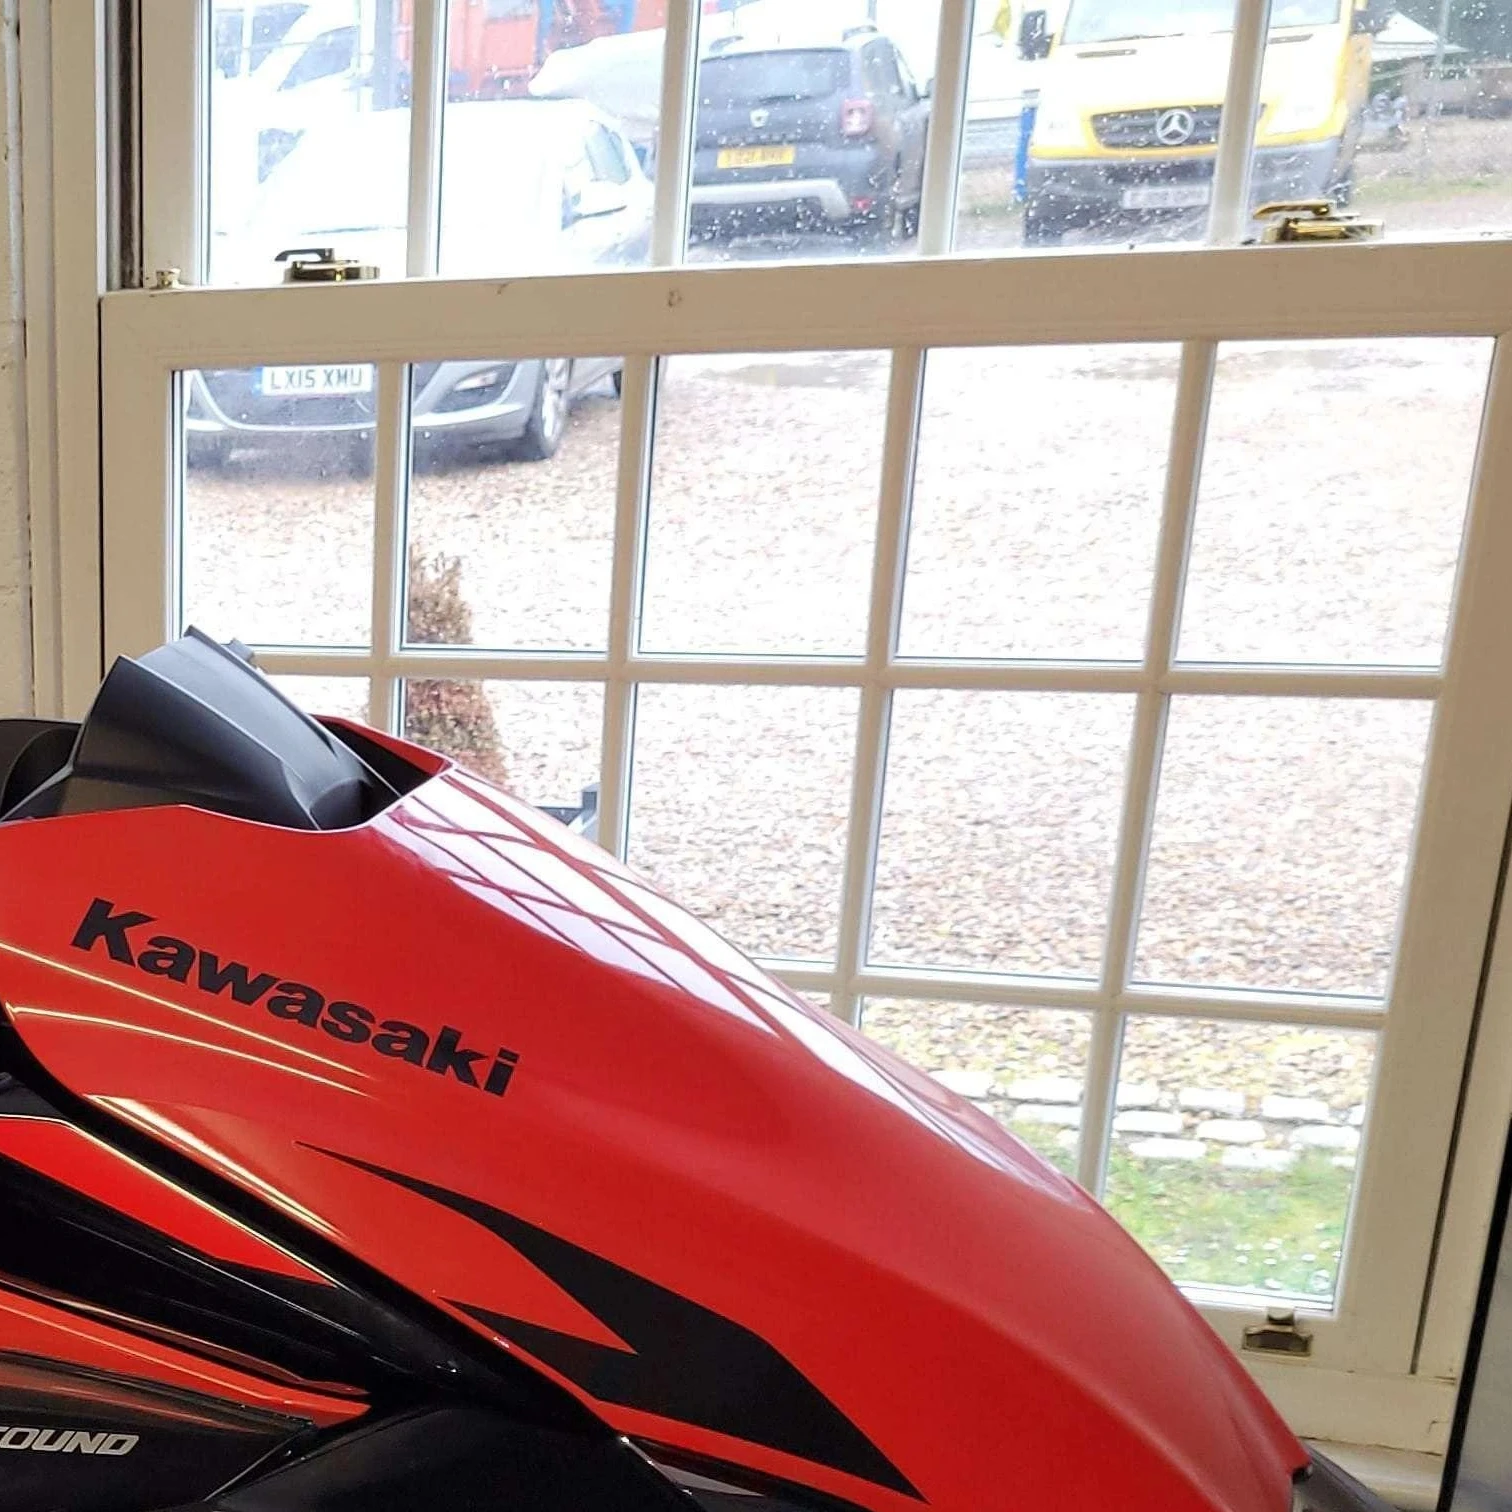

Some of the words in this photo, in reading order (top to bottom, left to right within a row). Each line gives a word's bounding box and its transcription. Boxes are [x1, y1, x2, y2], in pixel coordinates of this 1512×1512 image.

[270, 369, 316, 390] LX15
[323, 367, 362, 388] XMU
[71, 897, 521, 1097] Kawasaki
